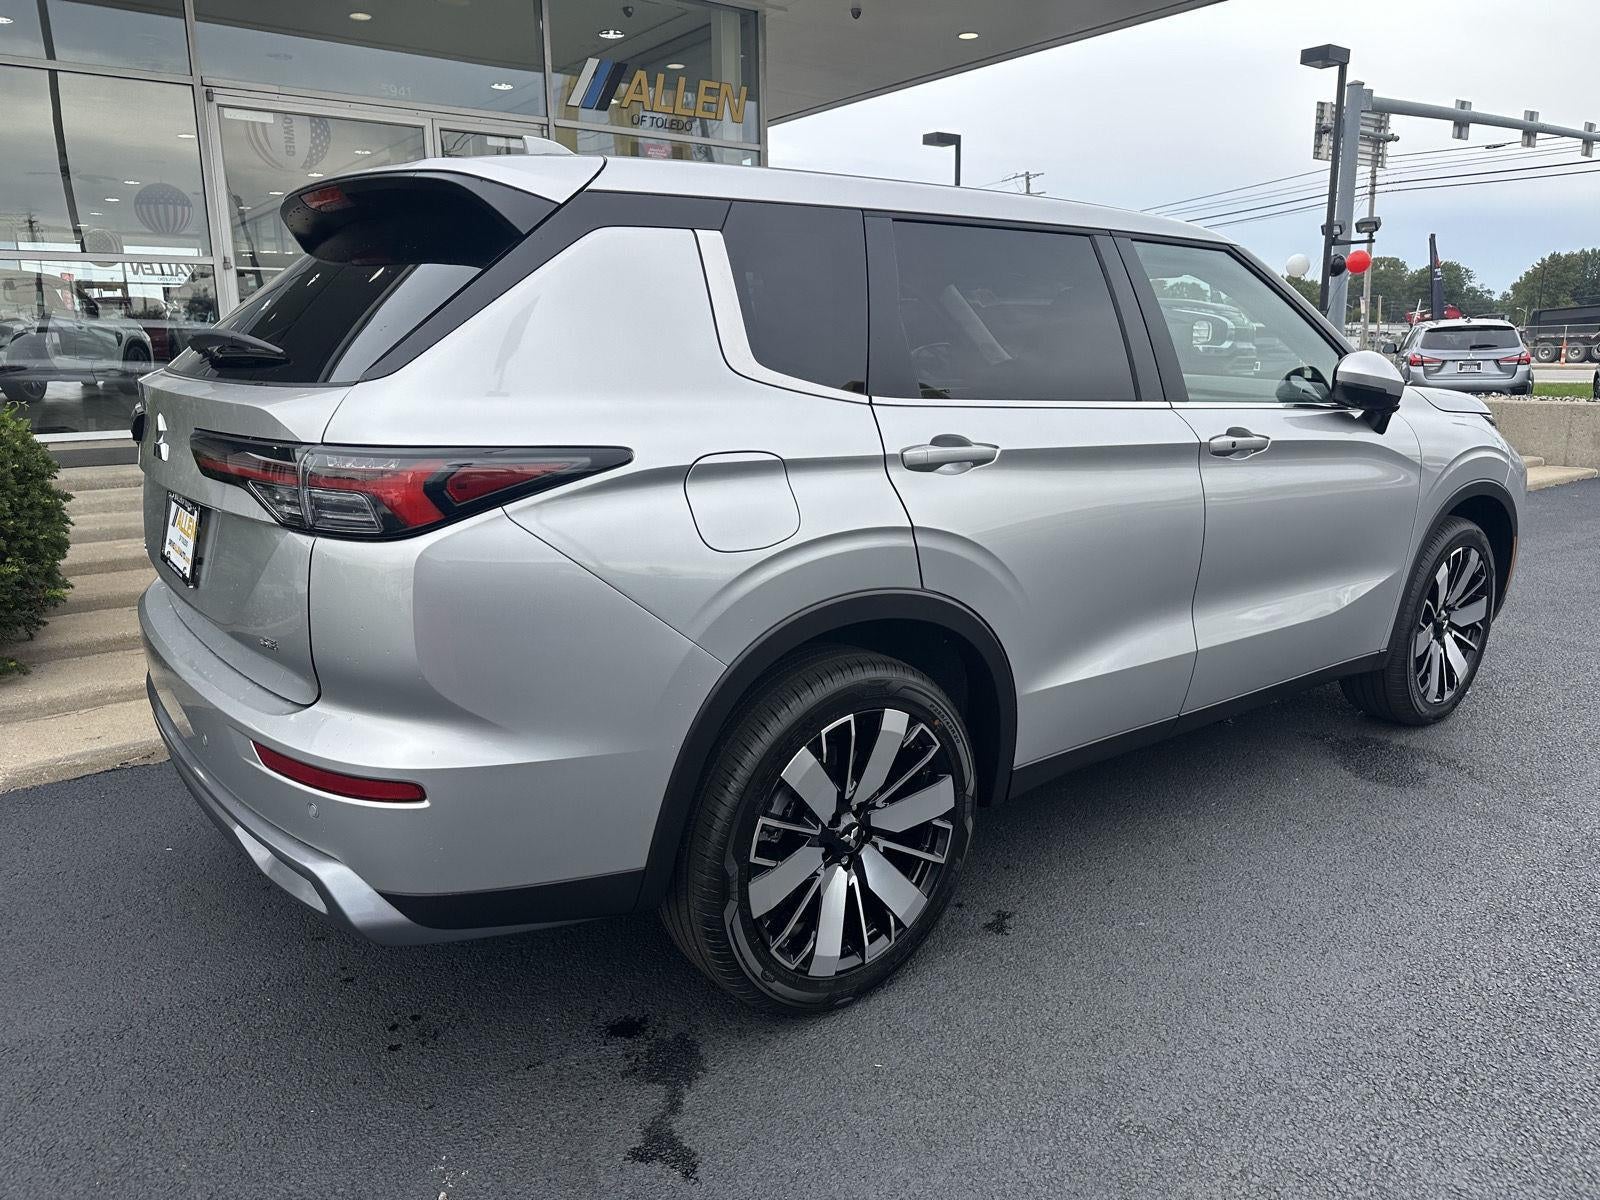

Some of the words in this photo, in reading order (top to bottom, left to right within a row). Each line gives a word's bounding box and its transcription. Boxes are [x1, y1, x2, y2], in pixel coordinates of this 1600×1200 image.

[620, 69, 748, 124] ALLEN
[632, 114, 647, 126] OF
[650, 116, 693, 132] TOLEDO
